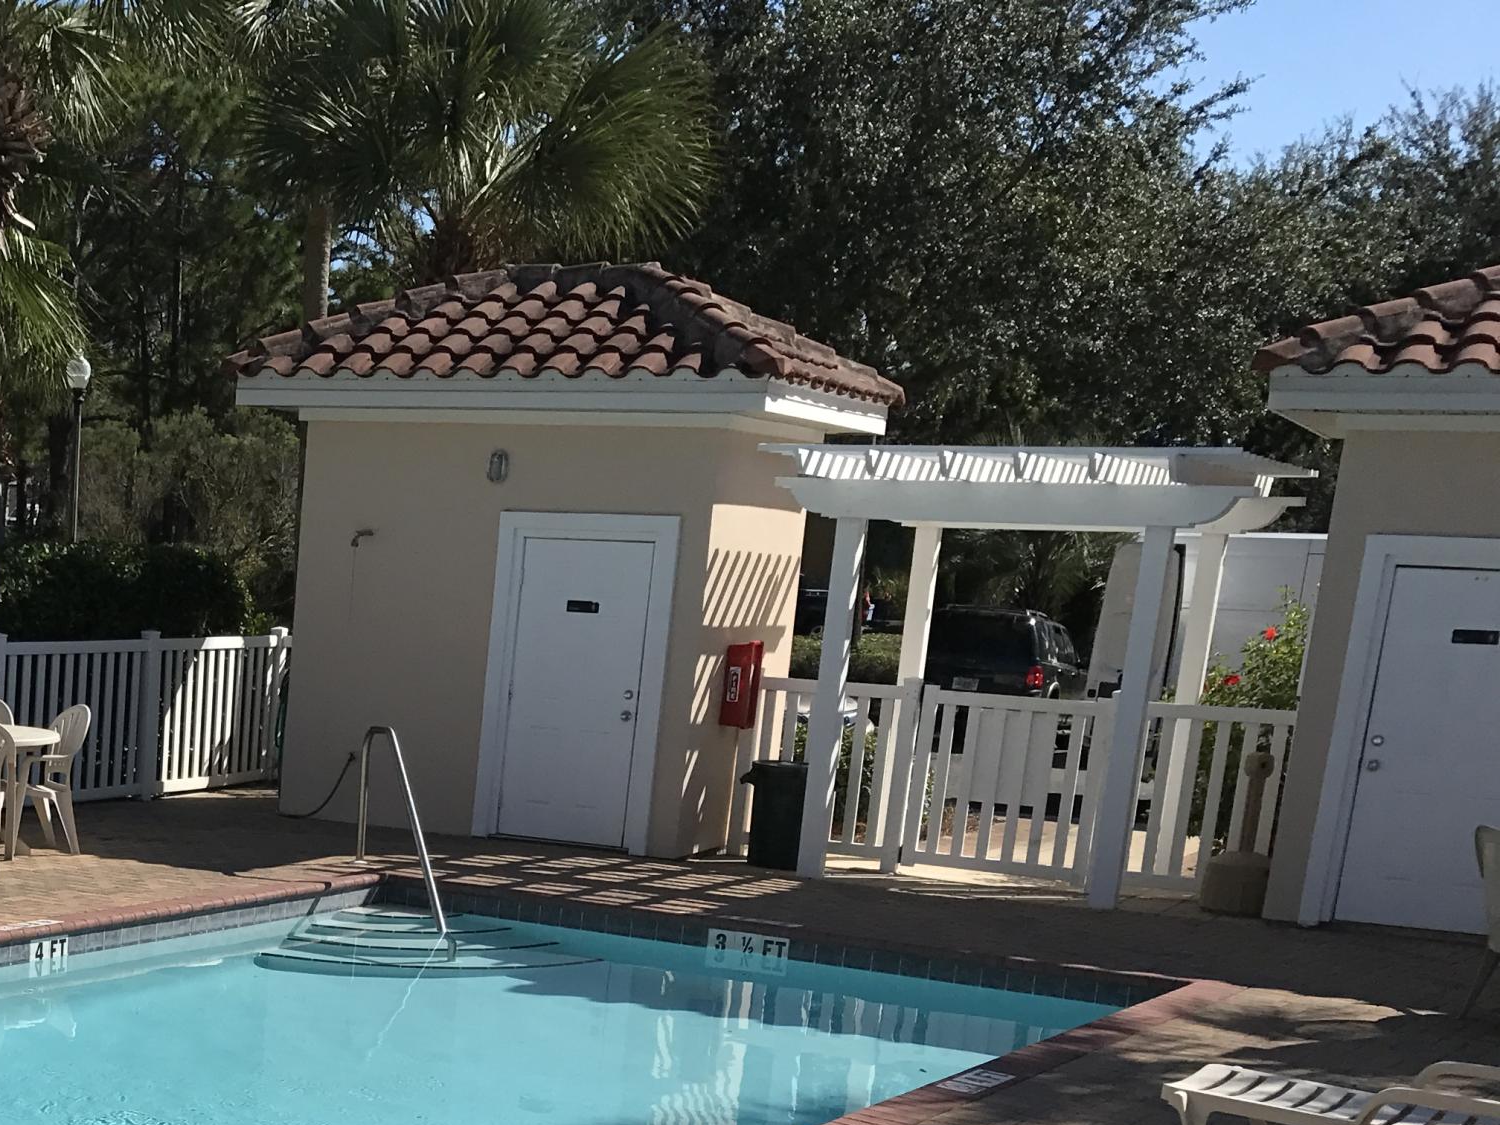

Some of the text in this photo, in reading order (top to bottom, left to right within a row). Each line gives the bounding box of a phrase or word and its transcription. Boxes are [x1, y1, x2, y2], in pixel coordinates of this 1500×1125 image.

[35, 938, 67, 960] 4 FT
[714, 933, 727, 950] 3
[762, 939, 787, 958] FT
